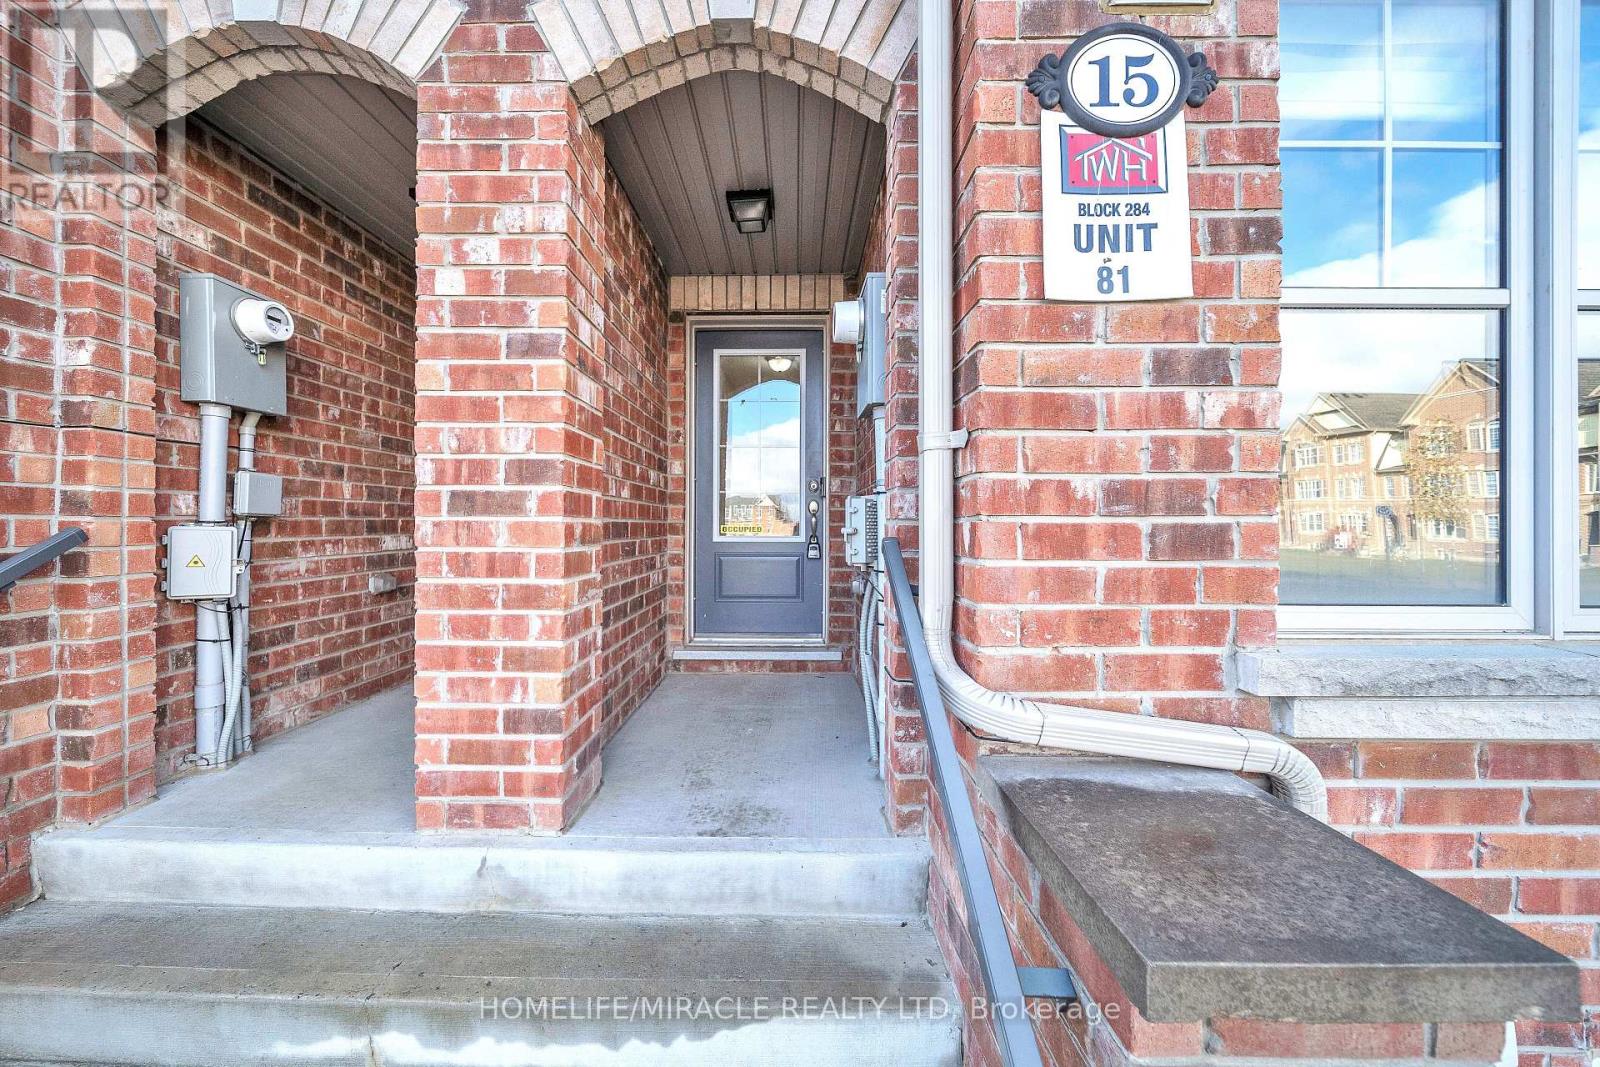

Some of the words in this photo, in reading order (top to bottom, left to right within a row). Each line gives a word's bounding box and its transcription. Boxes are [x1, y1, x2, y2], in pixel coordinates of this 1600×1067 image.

[1088, 53, 1159, 107] 15
[1078, 202, 1121, 218] BLOCK
[1125, 202, 1151, 217] 284
[1073, 223, 1159, 254] UNIT
[1097, 265, 1130, 295] 81
